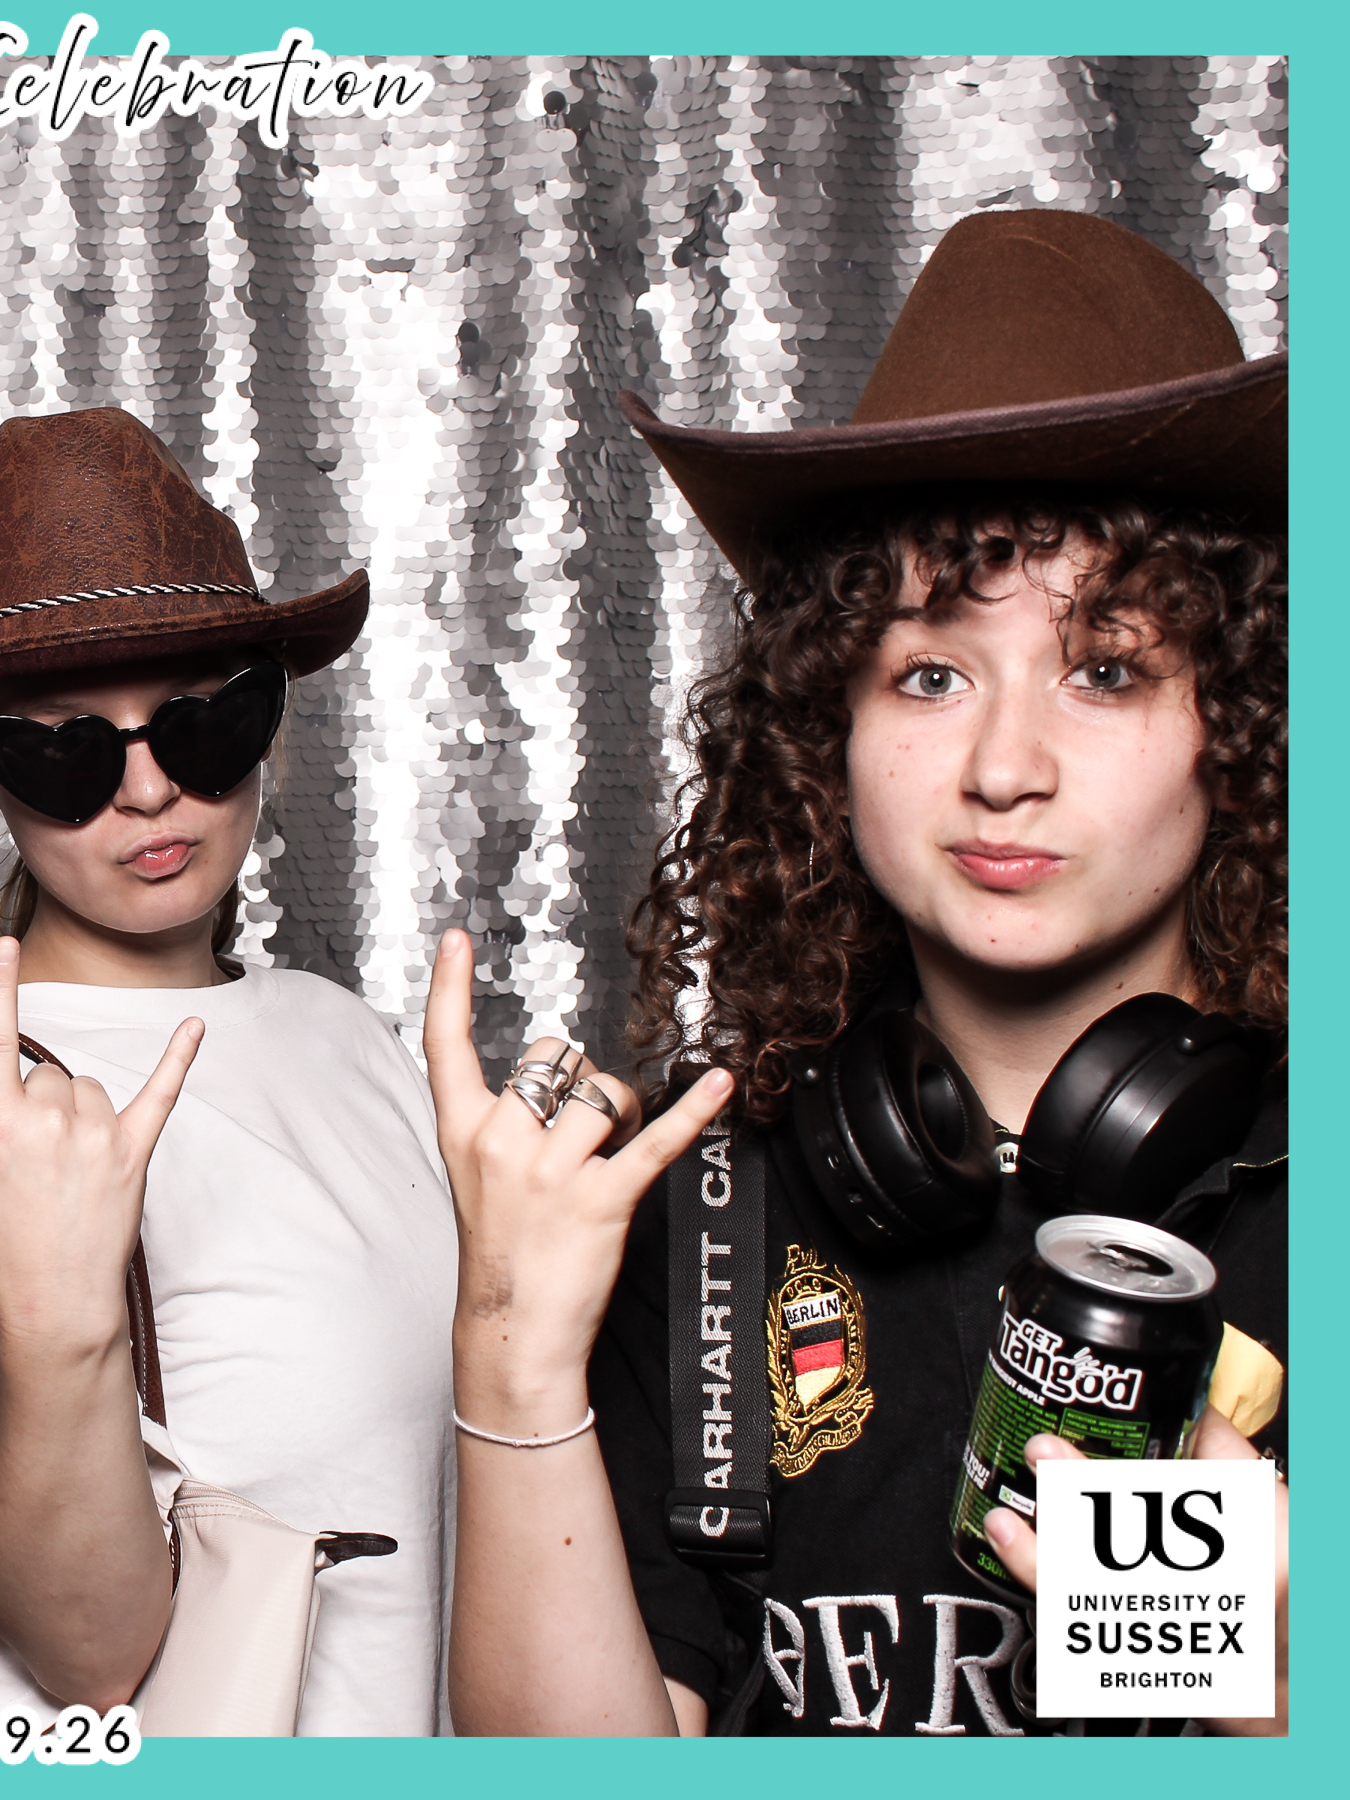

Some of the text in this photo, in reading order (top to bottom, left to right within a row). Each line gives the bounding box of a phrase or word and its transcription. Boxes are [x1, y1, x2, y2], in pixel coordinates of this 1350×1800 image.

[786, 1297, 839, 1325] BERLIN
[1021, 1323, 1060, 1351] GET
[1002, 1314, 1140, 1408] Tango'd
[699, 1231, 733, 1538] CARHARTT
[969, 1450, 991, 1482] YOU!
